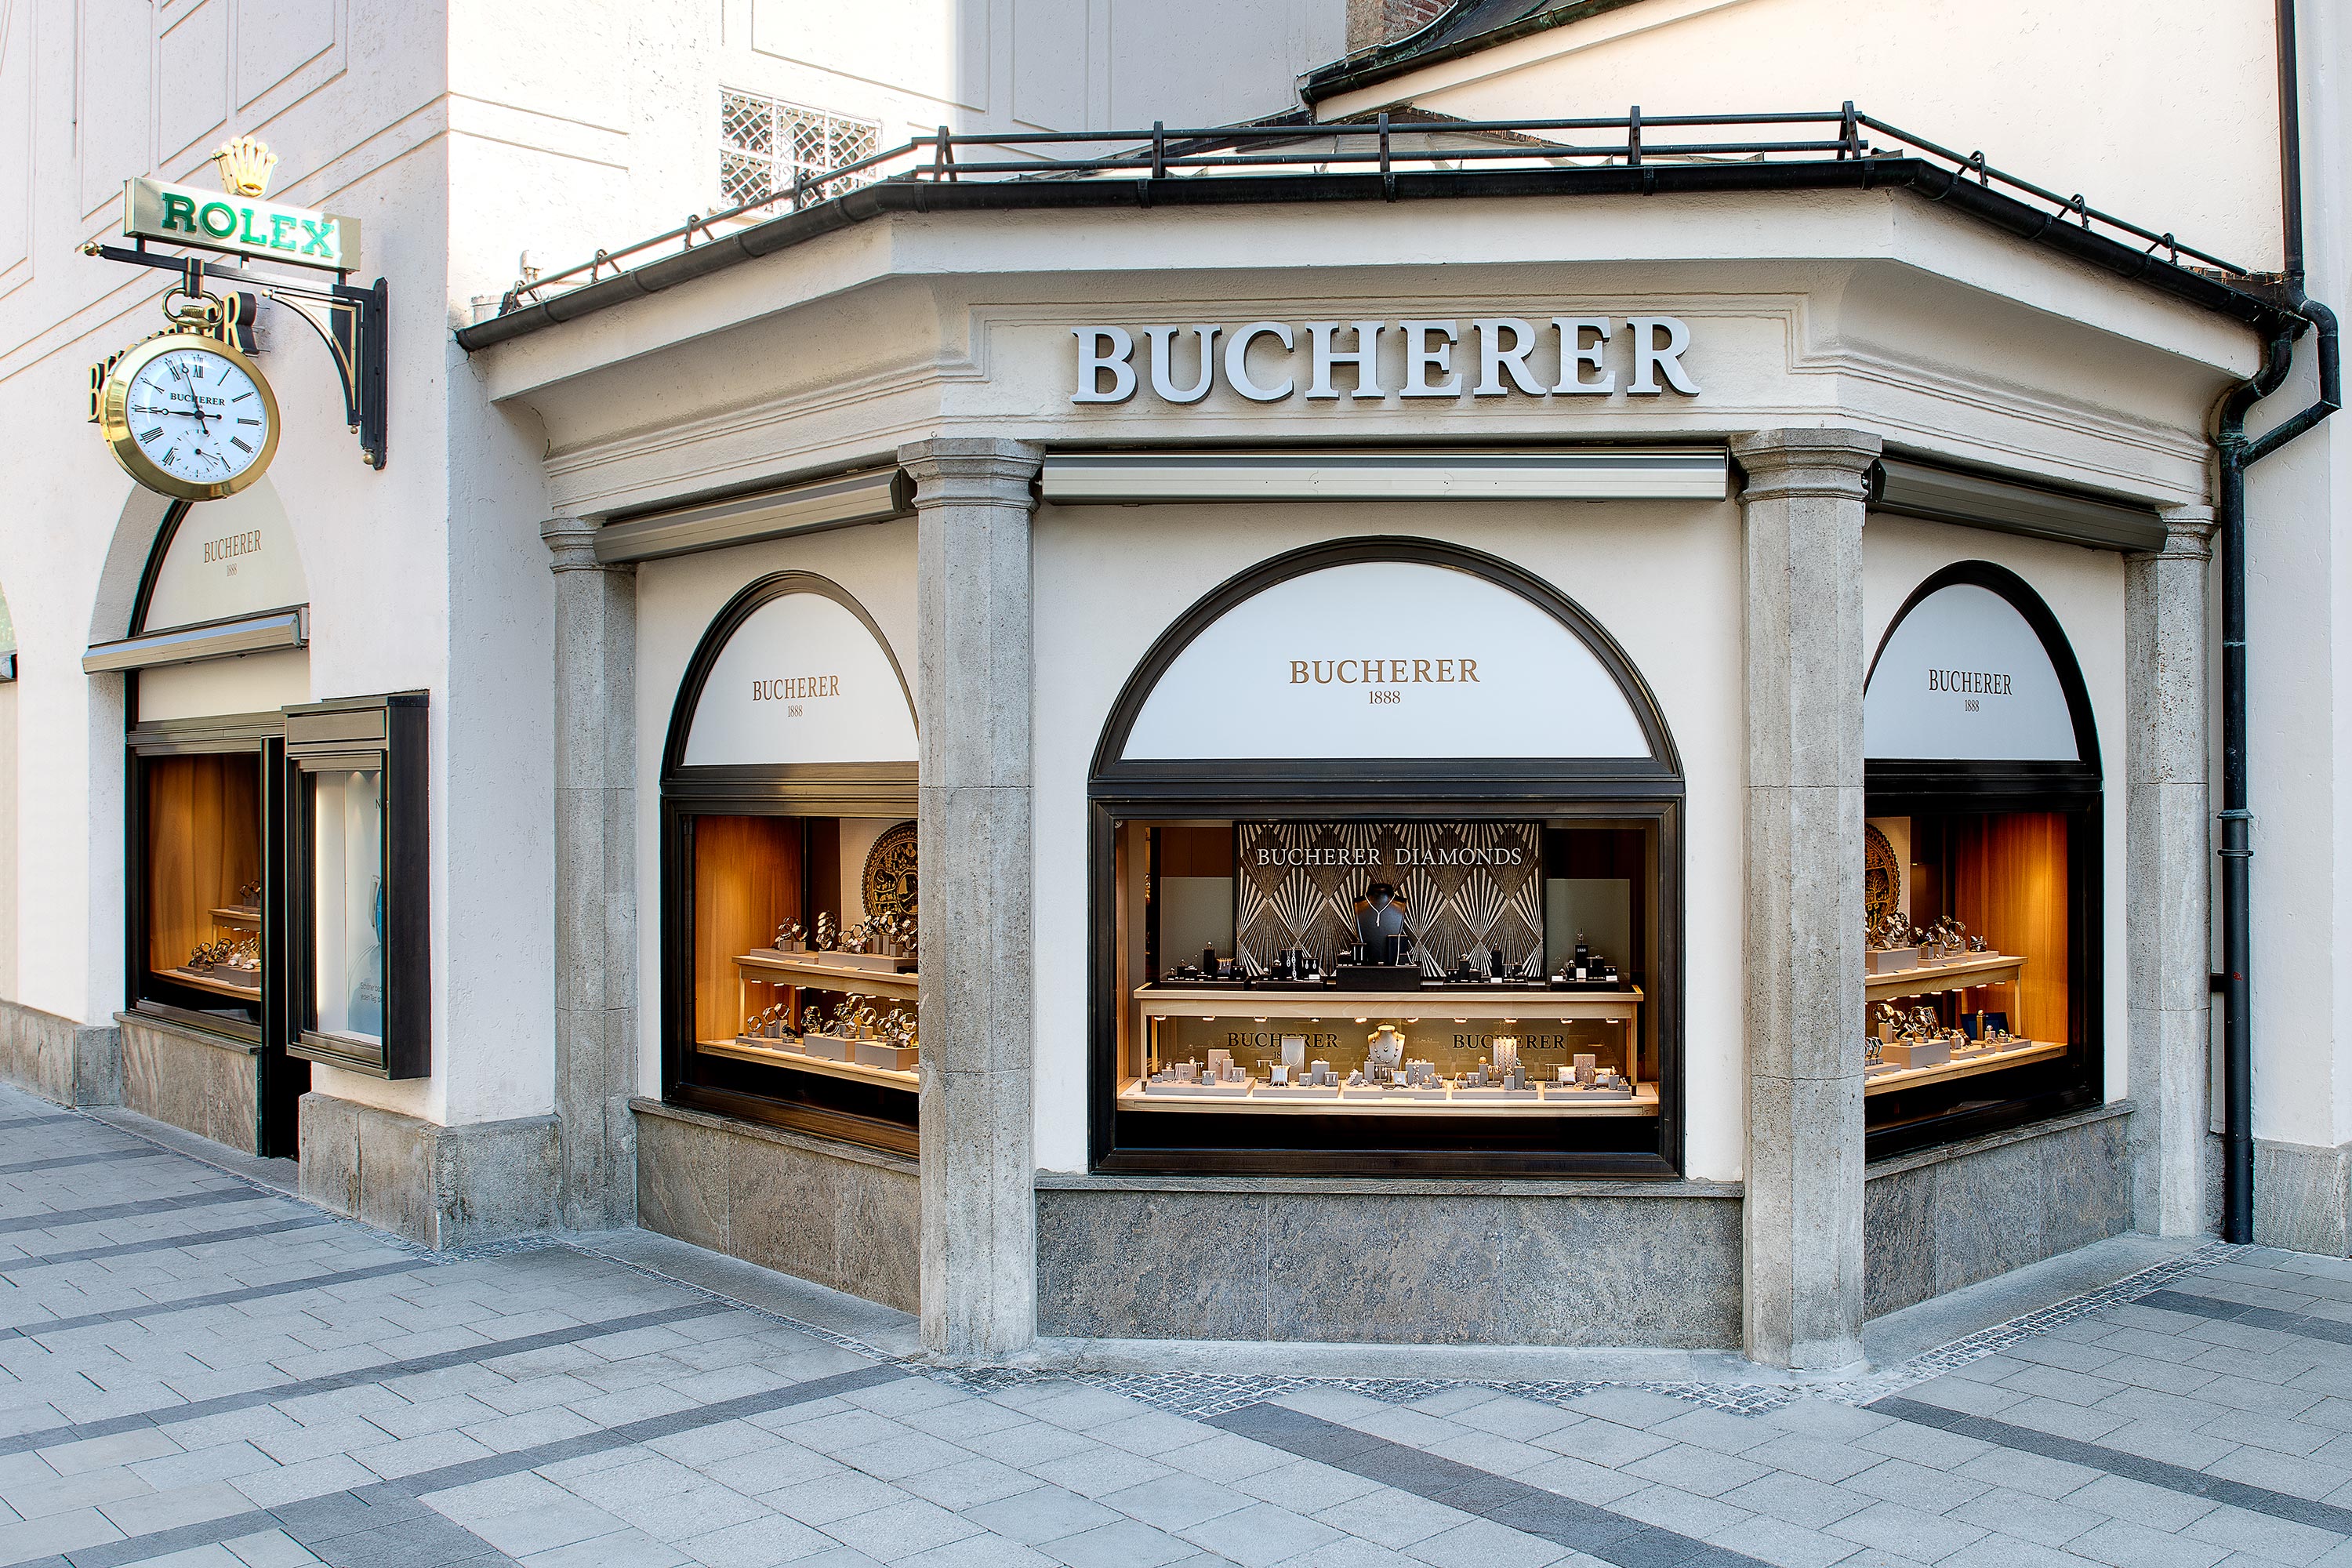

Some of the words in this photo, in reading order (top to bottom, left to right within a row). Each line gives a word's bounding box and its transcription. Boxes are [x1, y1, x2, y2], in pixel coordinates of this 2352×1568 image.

[162, 192, 335, 258] ROLEX
[1070, 317, 1700, 405] BUCHERER
[204, 529, 262, 564] BUCHERER
[1289, 659, 1480, 684] BUCHERER
[1929, 669, 2013, 695] BUCHERER
[753, 675, 840, 701] BUCHERER
[1368, 690, 1401, 705] 1888
[788, 705, 803, 717] 1888
[1965, 699, 1980, 712] 1888
[1257, 848, 1382, 866] BUCHERER
[1395, 848, 1523, 866] DIAMONDS
[1227, 1033, 1339, 1048] BUCHRER
[1453, 1034, 1566, 1050] BUCERER
